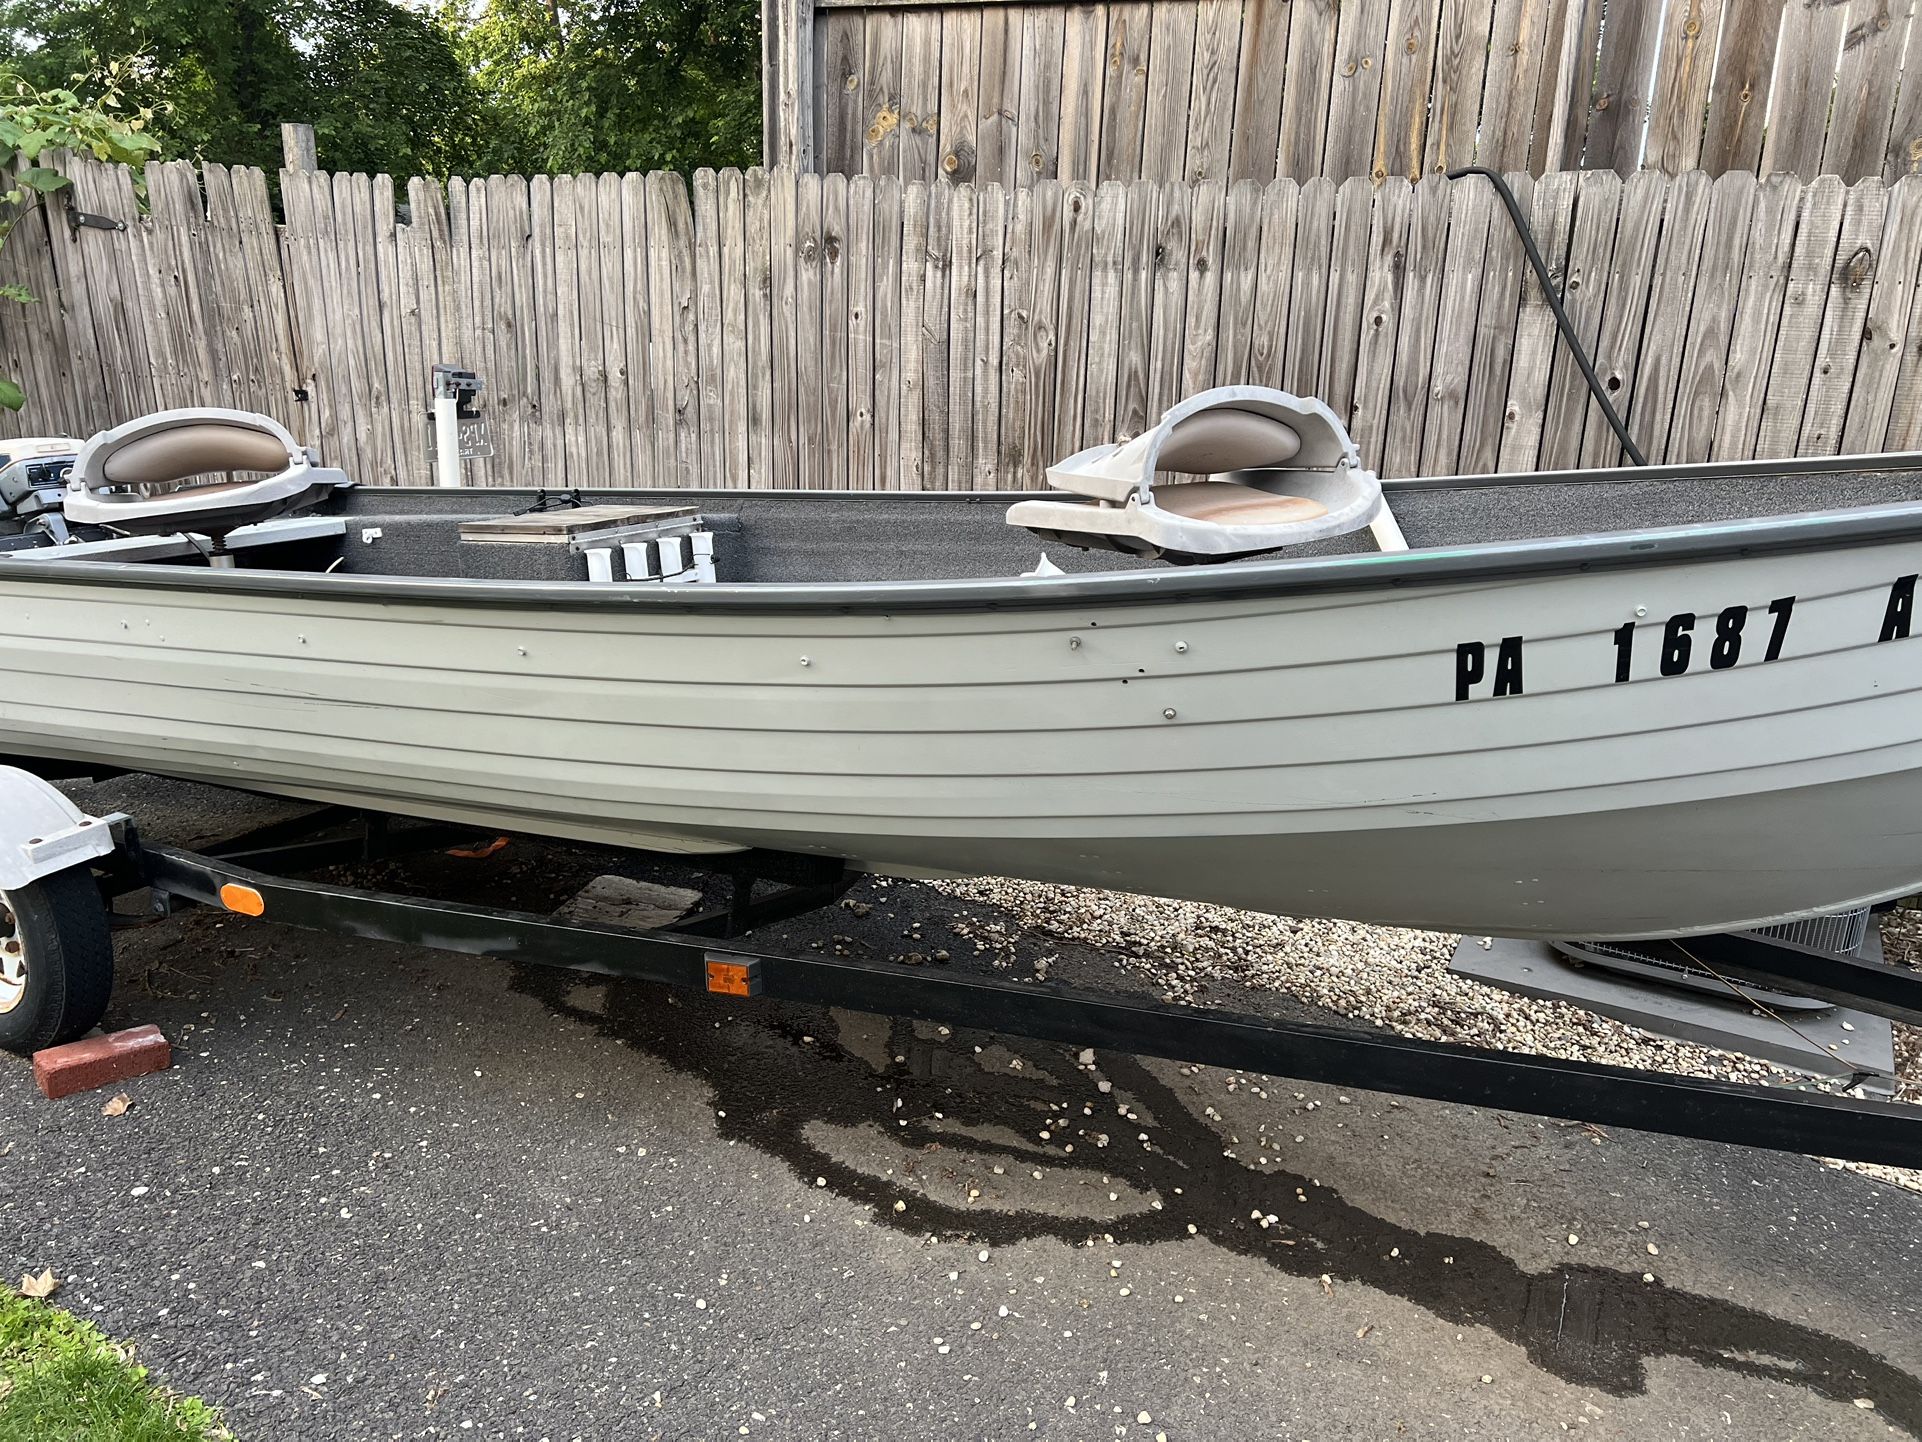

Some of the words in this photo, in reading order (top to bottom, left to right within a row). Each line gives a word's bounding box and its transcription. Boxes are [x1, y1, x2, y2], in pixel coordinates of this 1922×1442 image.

[1456, 636, 1523, 701] PA
[1614, 596, 1796, 682] 1687
[1878, 573, 1919, 643] A
